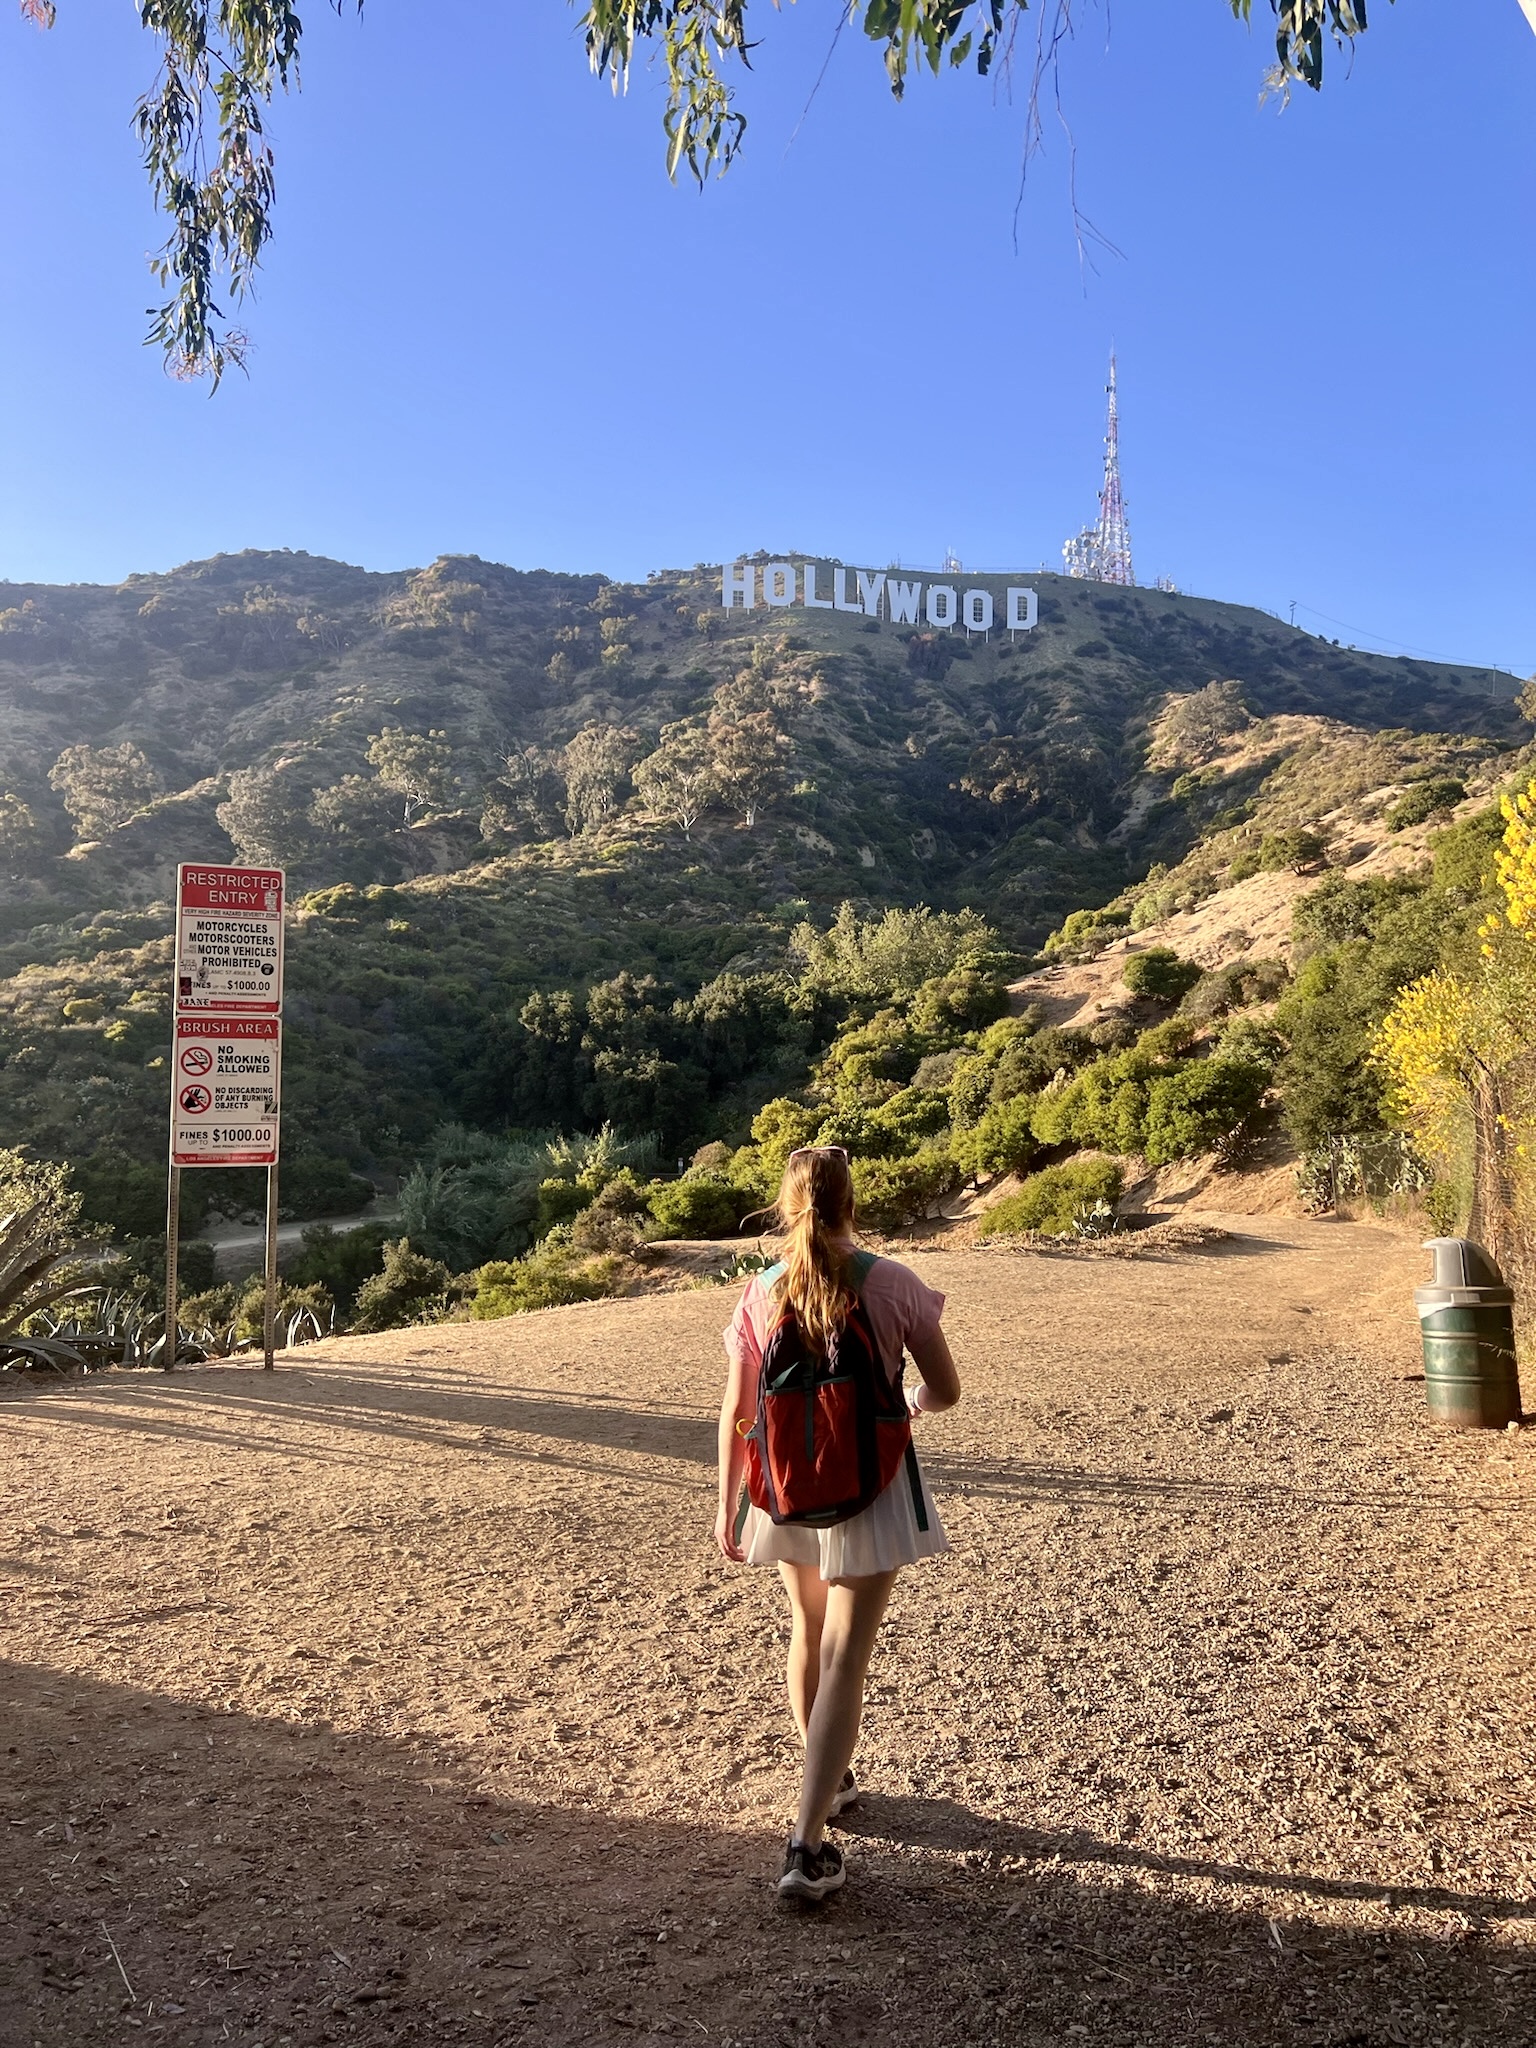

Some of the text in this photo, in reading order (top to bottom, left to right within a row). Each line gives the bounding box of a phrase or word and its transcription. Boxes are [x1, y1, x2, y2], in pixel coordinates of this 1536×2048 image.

[722, 563, 1038, 632] HOLLYWOOD
[186, 872, 280, 890] RESTRICTED
[209, 890, 258, 904] ENTRY
[196, 921, 268, 934] MOTORCYCLES
[189, 933, 275, 946] MOTORSCOOTERS
[198, 945, 277, 957] MOTOR VEHICLES
[202, 957, 261, 968] PROHIBITED
[227, 980, 270, 991] $1000.00
[183, 1022, 272, 1034] BRUSH AREA
[217, 1046, 234, 1054] NO
[217, 1056, 270, 1064] SMOKING
[217, 1064, 270, 1073] ALLOWED
[212, 1128, 271, 1142] $1000.00
